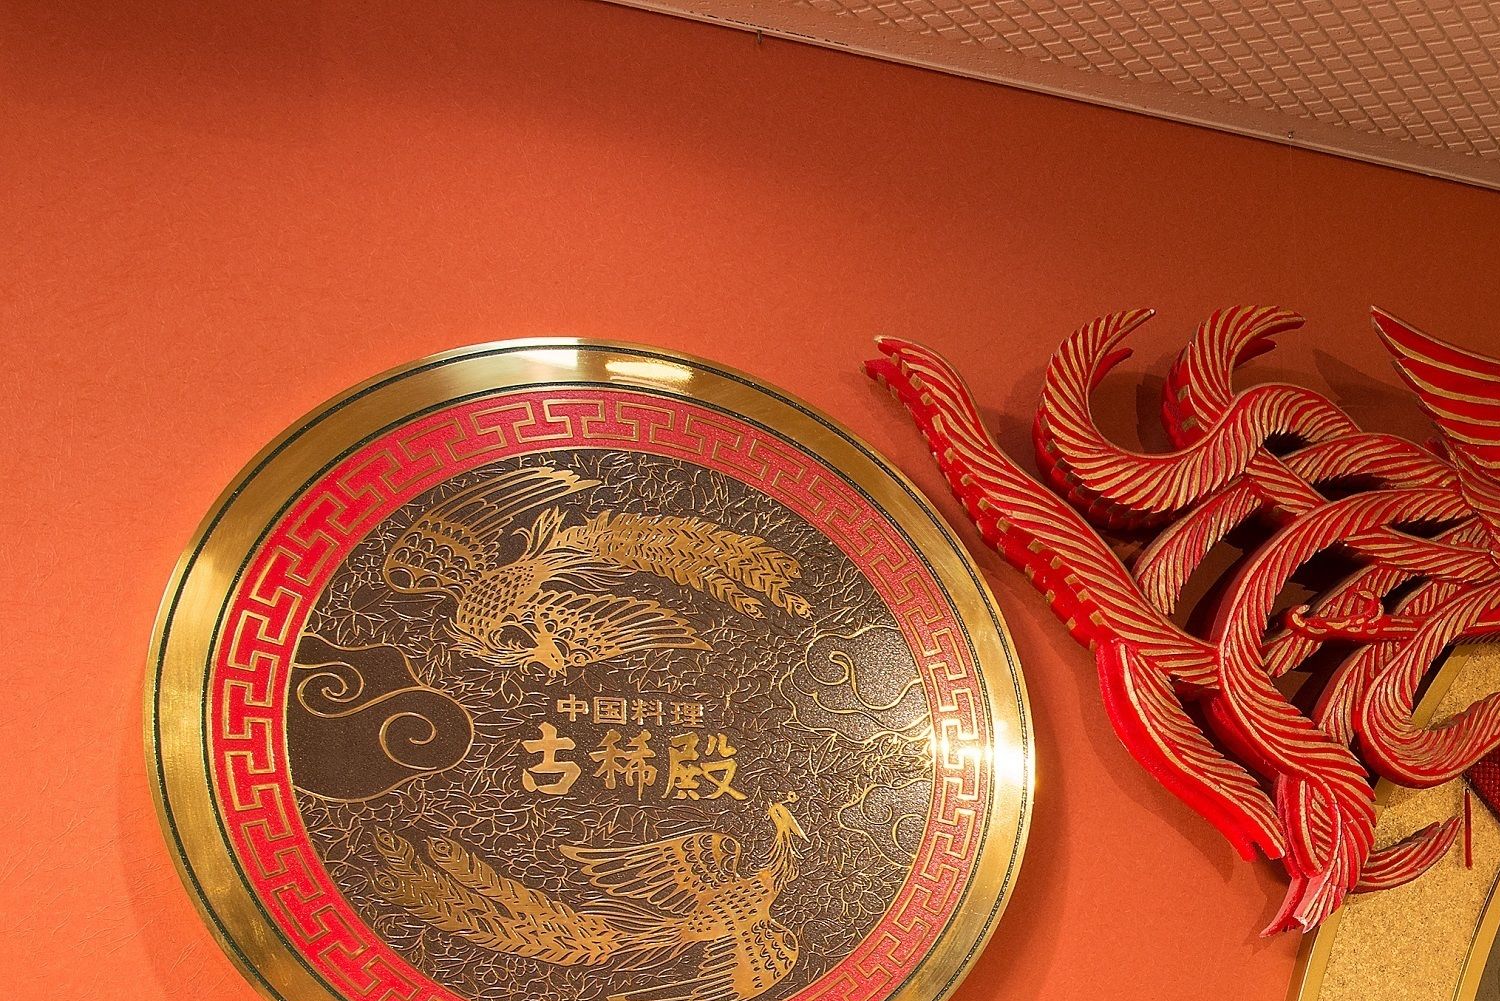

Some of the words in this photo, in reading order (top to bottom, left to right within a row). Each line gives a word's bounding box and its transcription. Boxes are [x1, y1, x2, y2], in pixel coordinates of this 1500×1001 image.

[556, 694, 704, 728] 中国料理
[521, 721, 748, 801] 古稀殿
